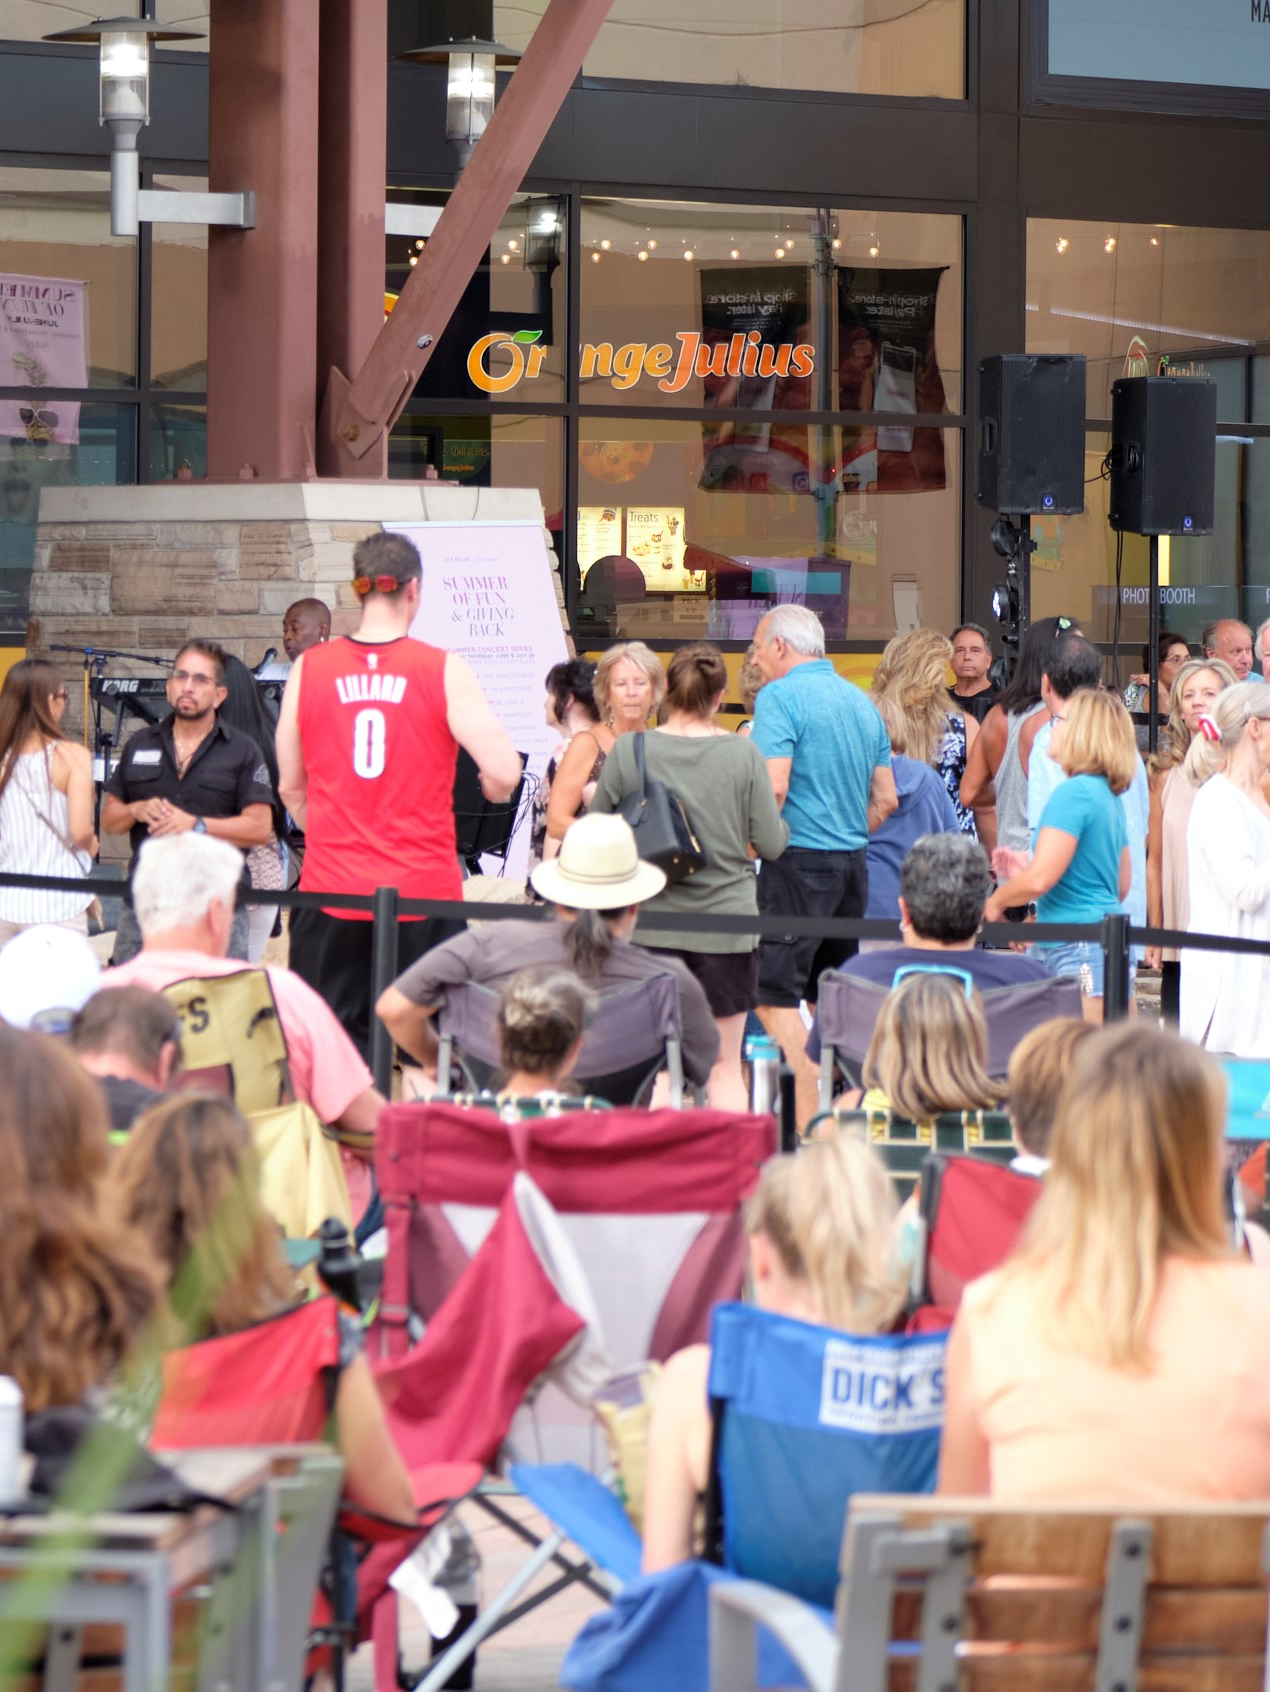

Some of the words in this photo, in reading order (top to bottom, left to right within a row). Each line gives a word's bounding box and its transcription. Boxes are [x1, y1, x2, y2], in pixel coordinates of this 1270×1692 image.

[467, 330, 674, 393] Ornge
[658, 331, 817, 394] Julius
[629, 511, 659, 523] Treats
[442, 576, 508, 591] SUMMER
[452, 591, 471, 606] OF
[476, 591, 506, 606] FUN
[1123, 588, 1150, 604] PHOT
[1160, 588, 1196, 604] BOOTH
[451, 610, 462, 622] &
[466, 607, 514, 621] GIVING
[470, 623, 505, 637] BACK
[446, 646, 476, 654] SUMMER
[353, 708, 386, 779] 0
